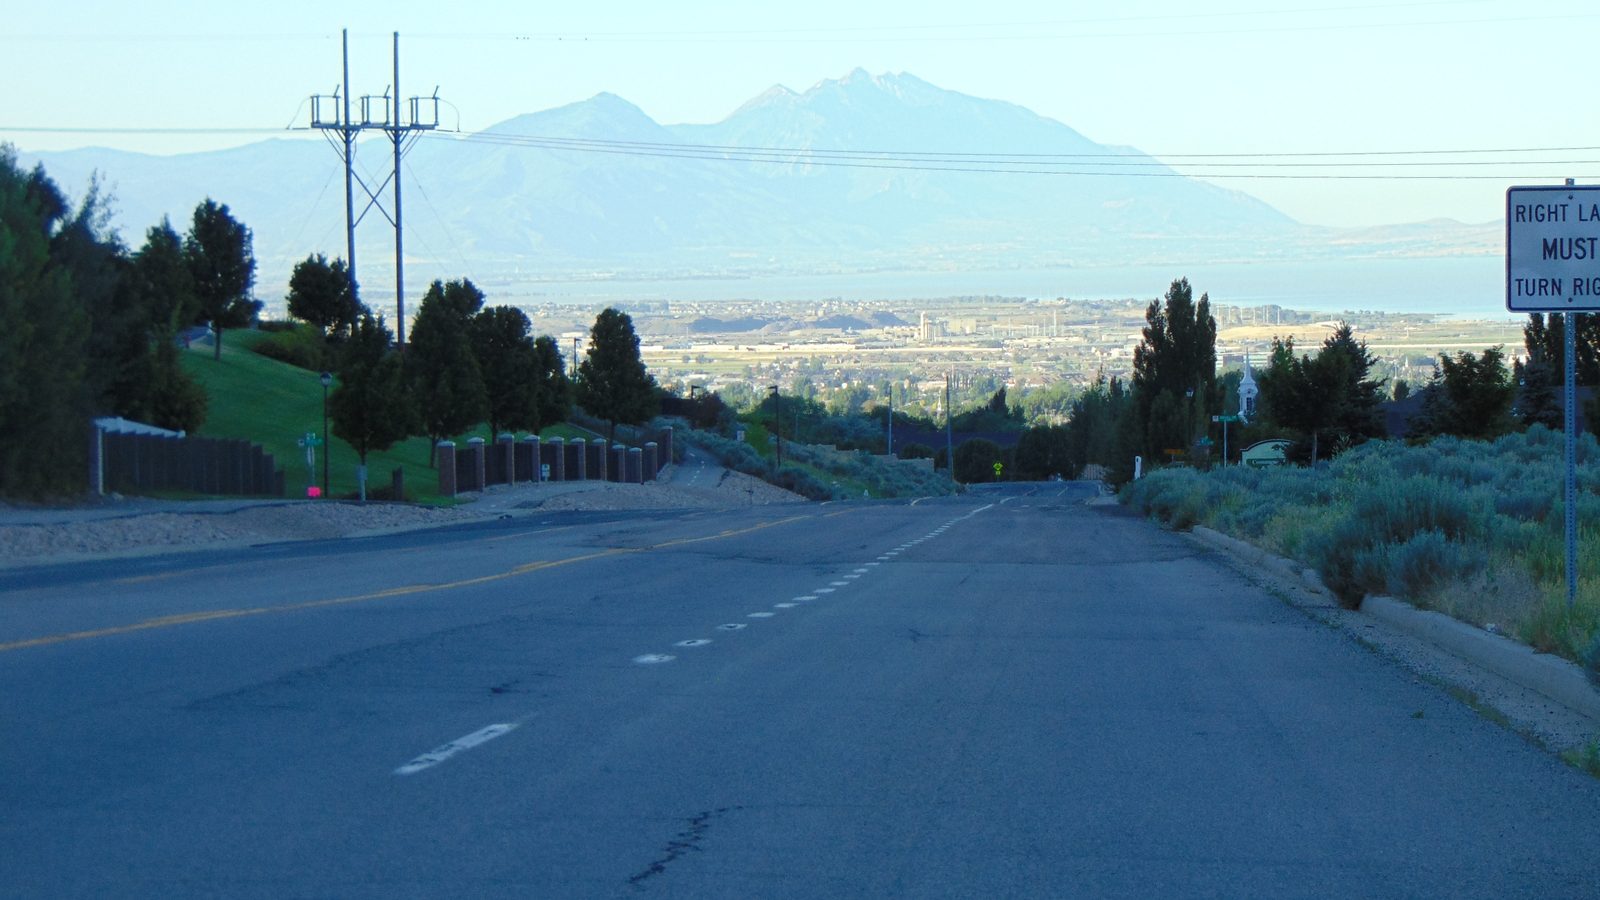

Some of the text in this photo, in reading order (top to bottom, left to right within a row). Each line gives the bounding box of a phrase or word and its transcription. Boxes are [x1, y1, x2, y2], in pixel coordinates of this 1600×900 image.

[1515, 204, 1568, 222] RIGHT
[1542, 237, 1598, 260] MUST
[1515, 278, 1562, 296] TURN
